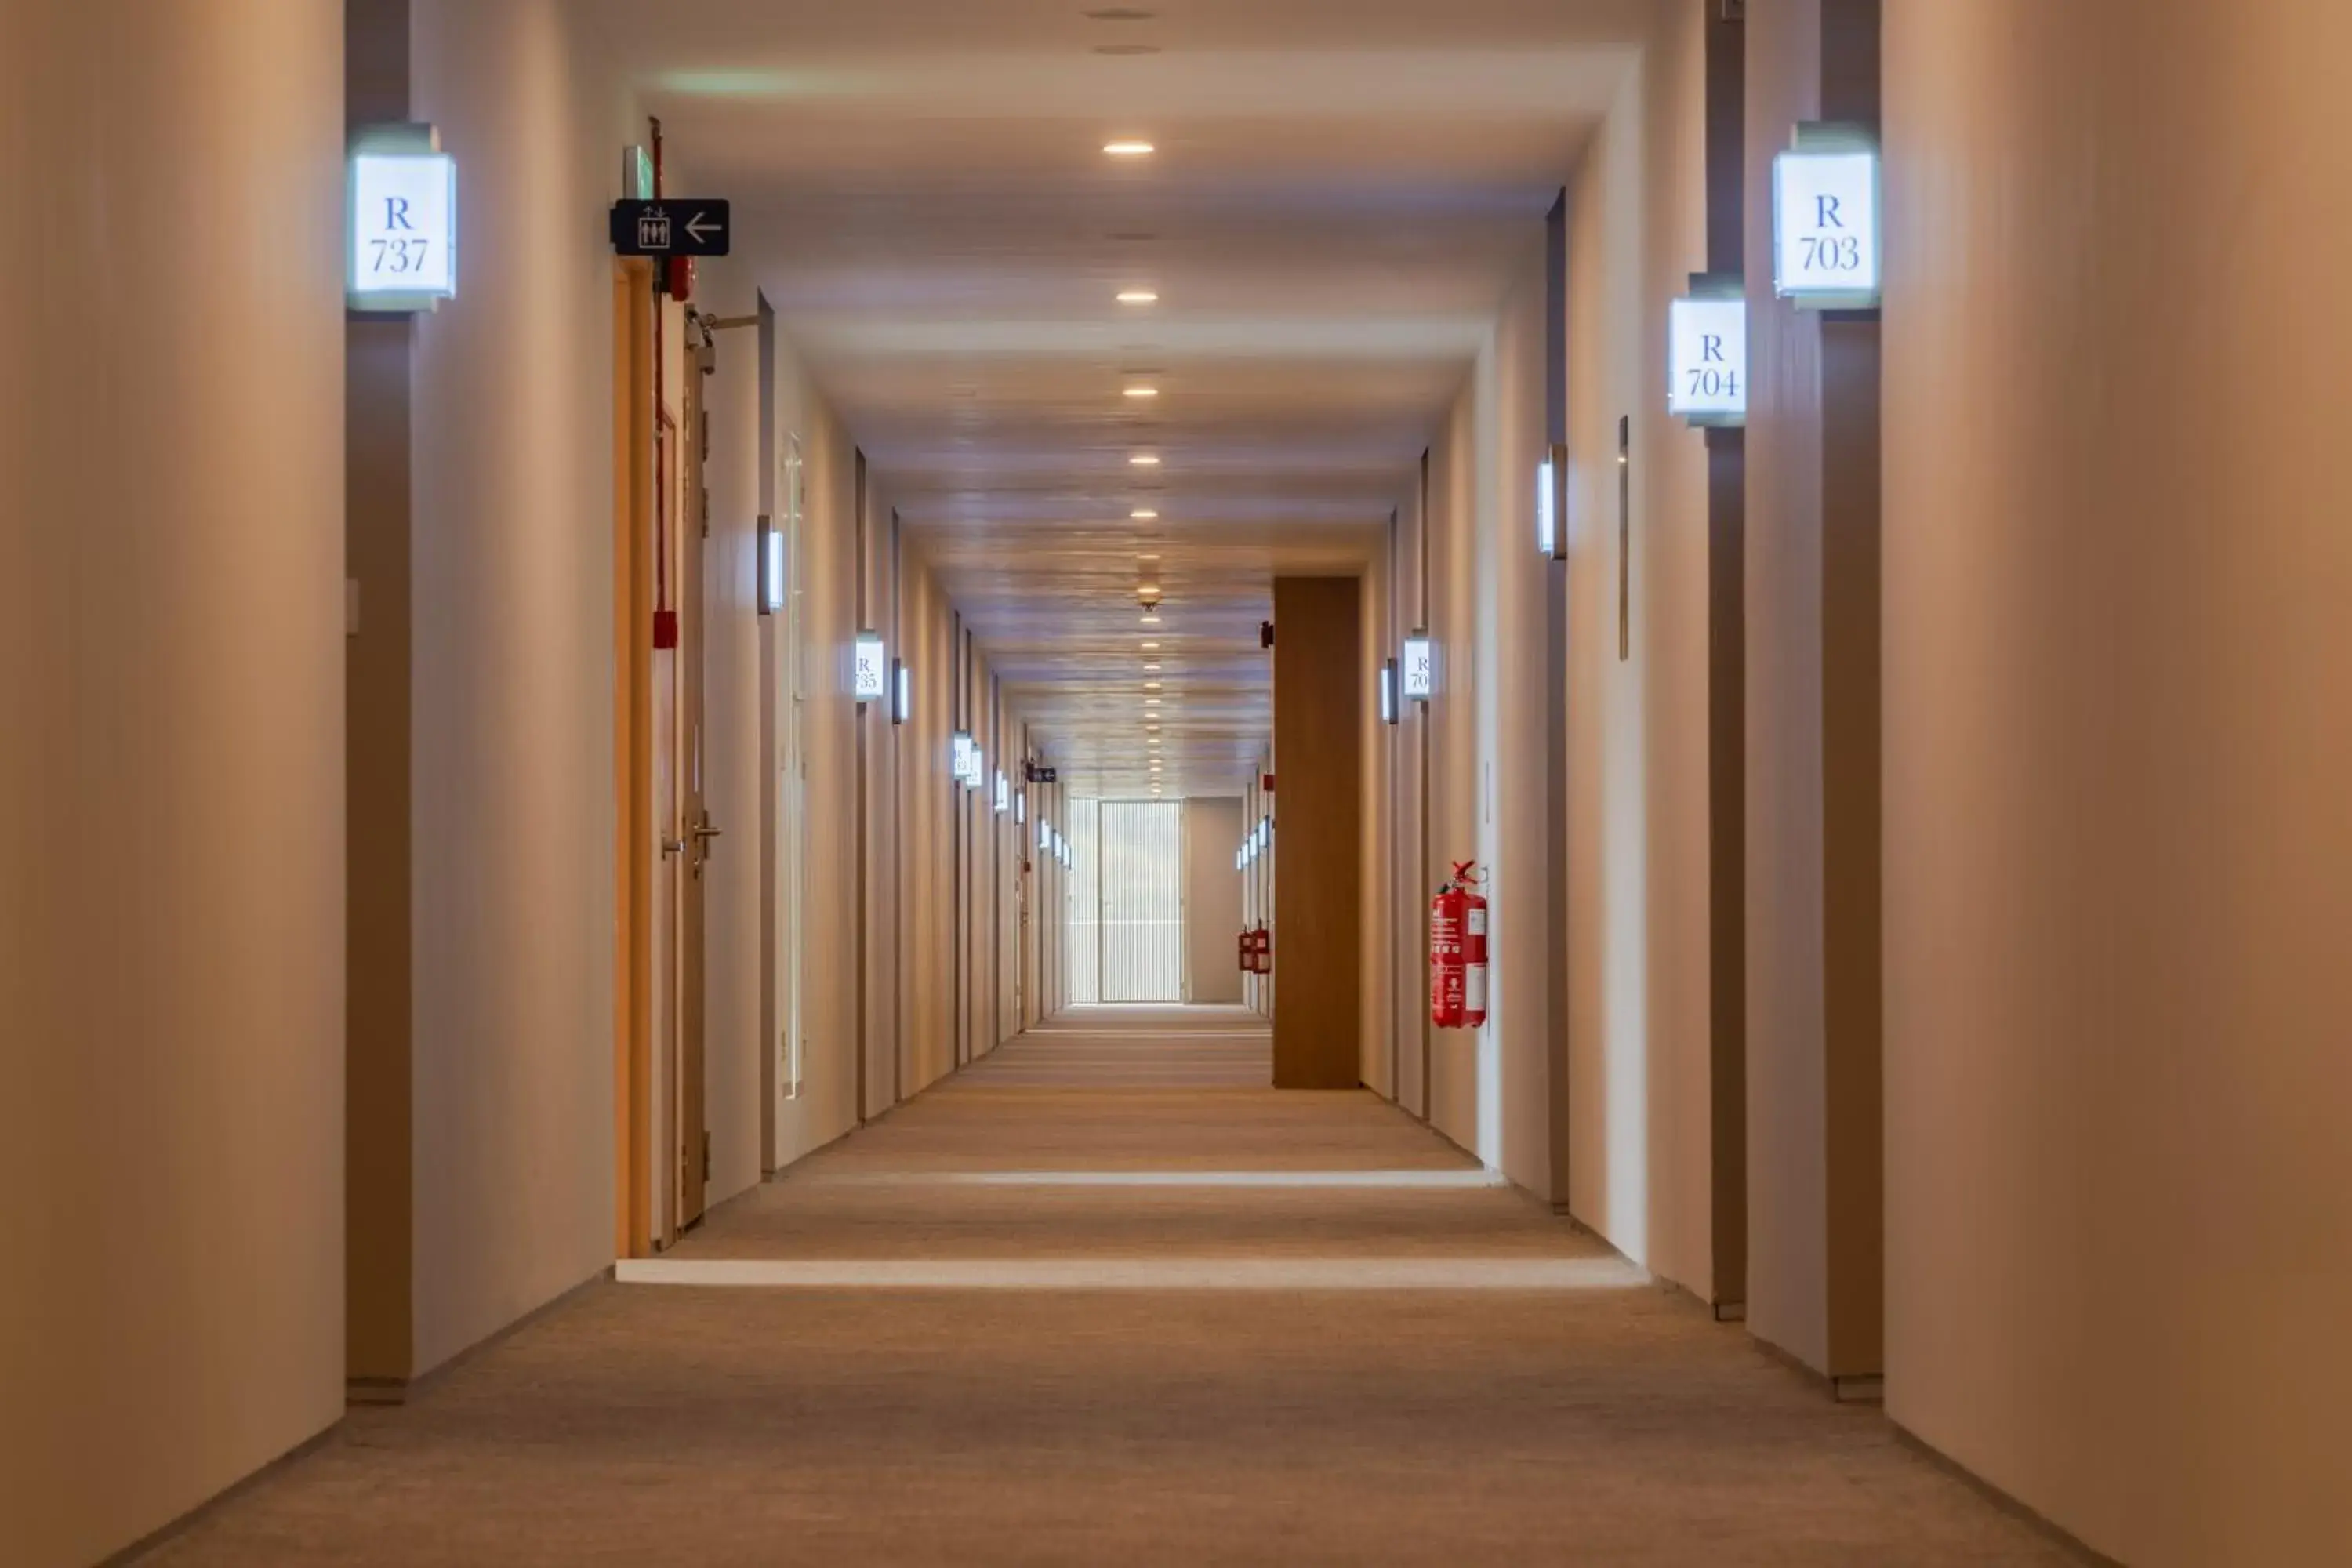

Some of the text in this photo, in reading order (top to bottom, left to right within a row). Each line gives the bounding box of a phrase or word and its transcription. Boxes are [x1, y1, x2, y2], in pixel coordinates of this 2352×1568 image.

[384, 197, 416, 230] R
[1817, 194, 1844, 227] R
[370, 238, 429, 272] 737
[1800, 236, 1859, 270] 703
[1701, 334, 1725, 361] R
[1687, 369, 1740, 396] 704
[859, 657, 869, 672] R
[1418, 657, 1429, 671] R
[1410, 673, 1428, 688] 70
